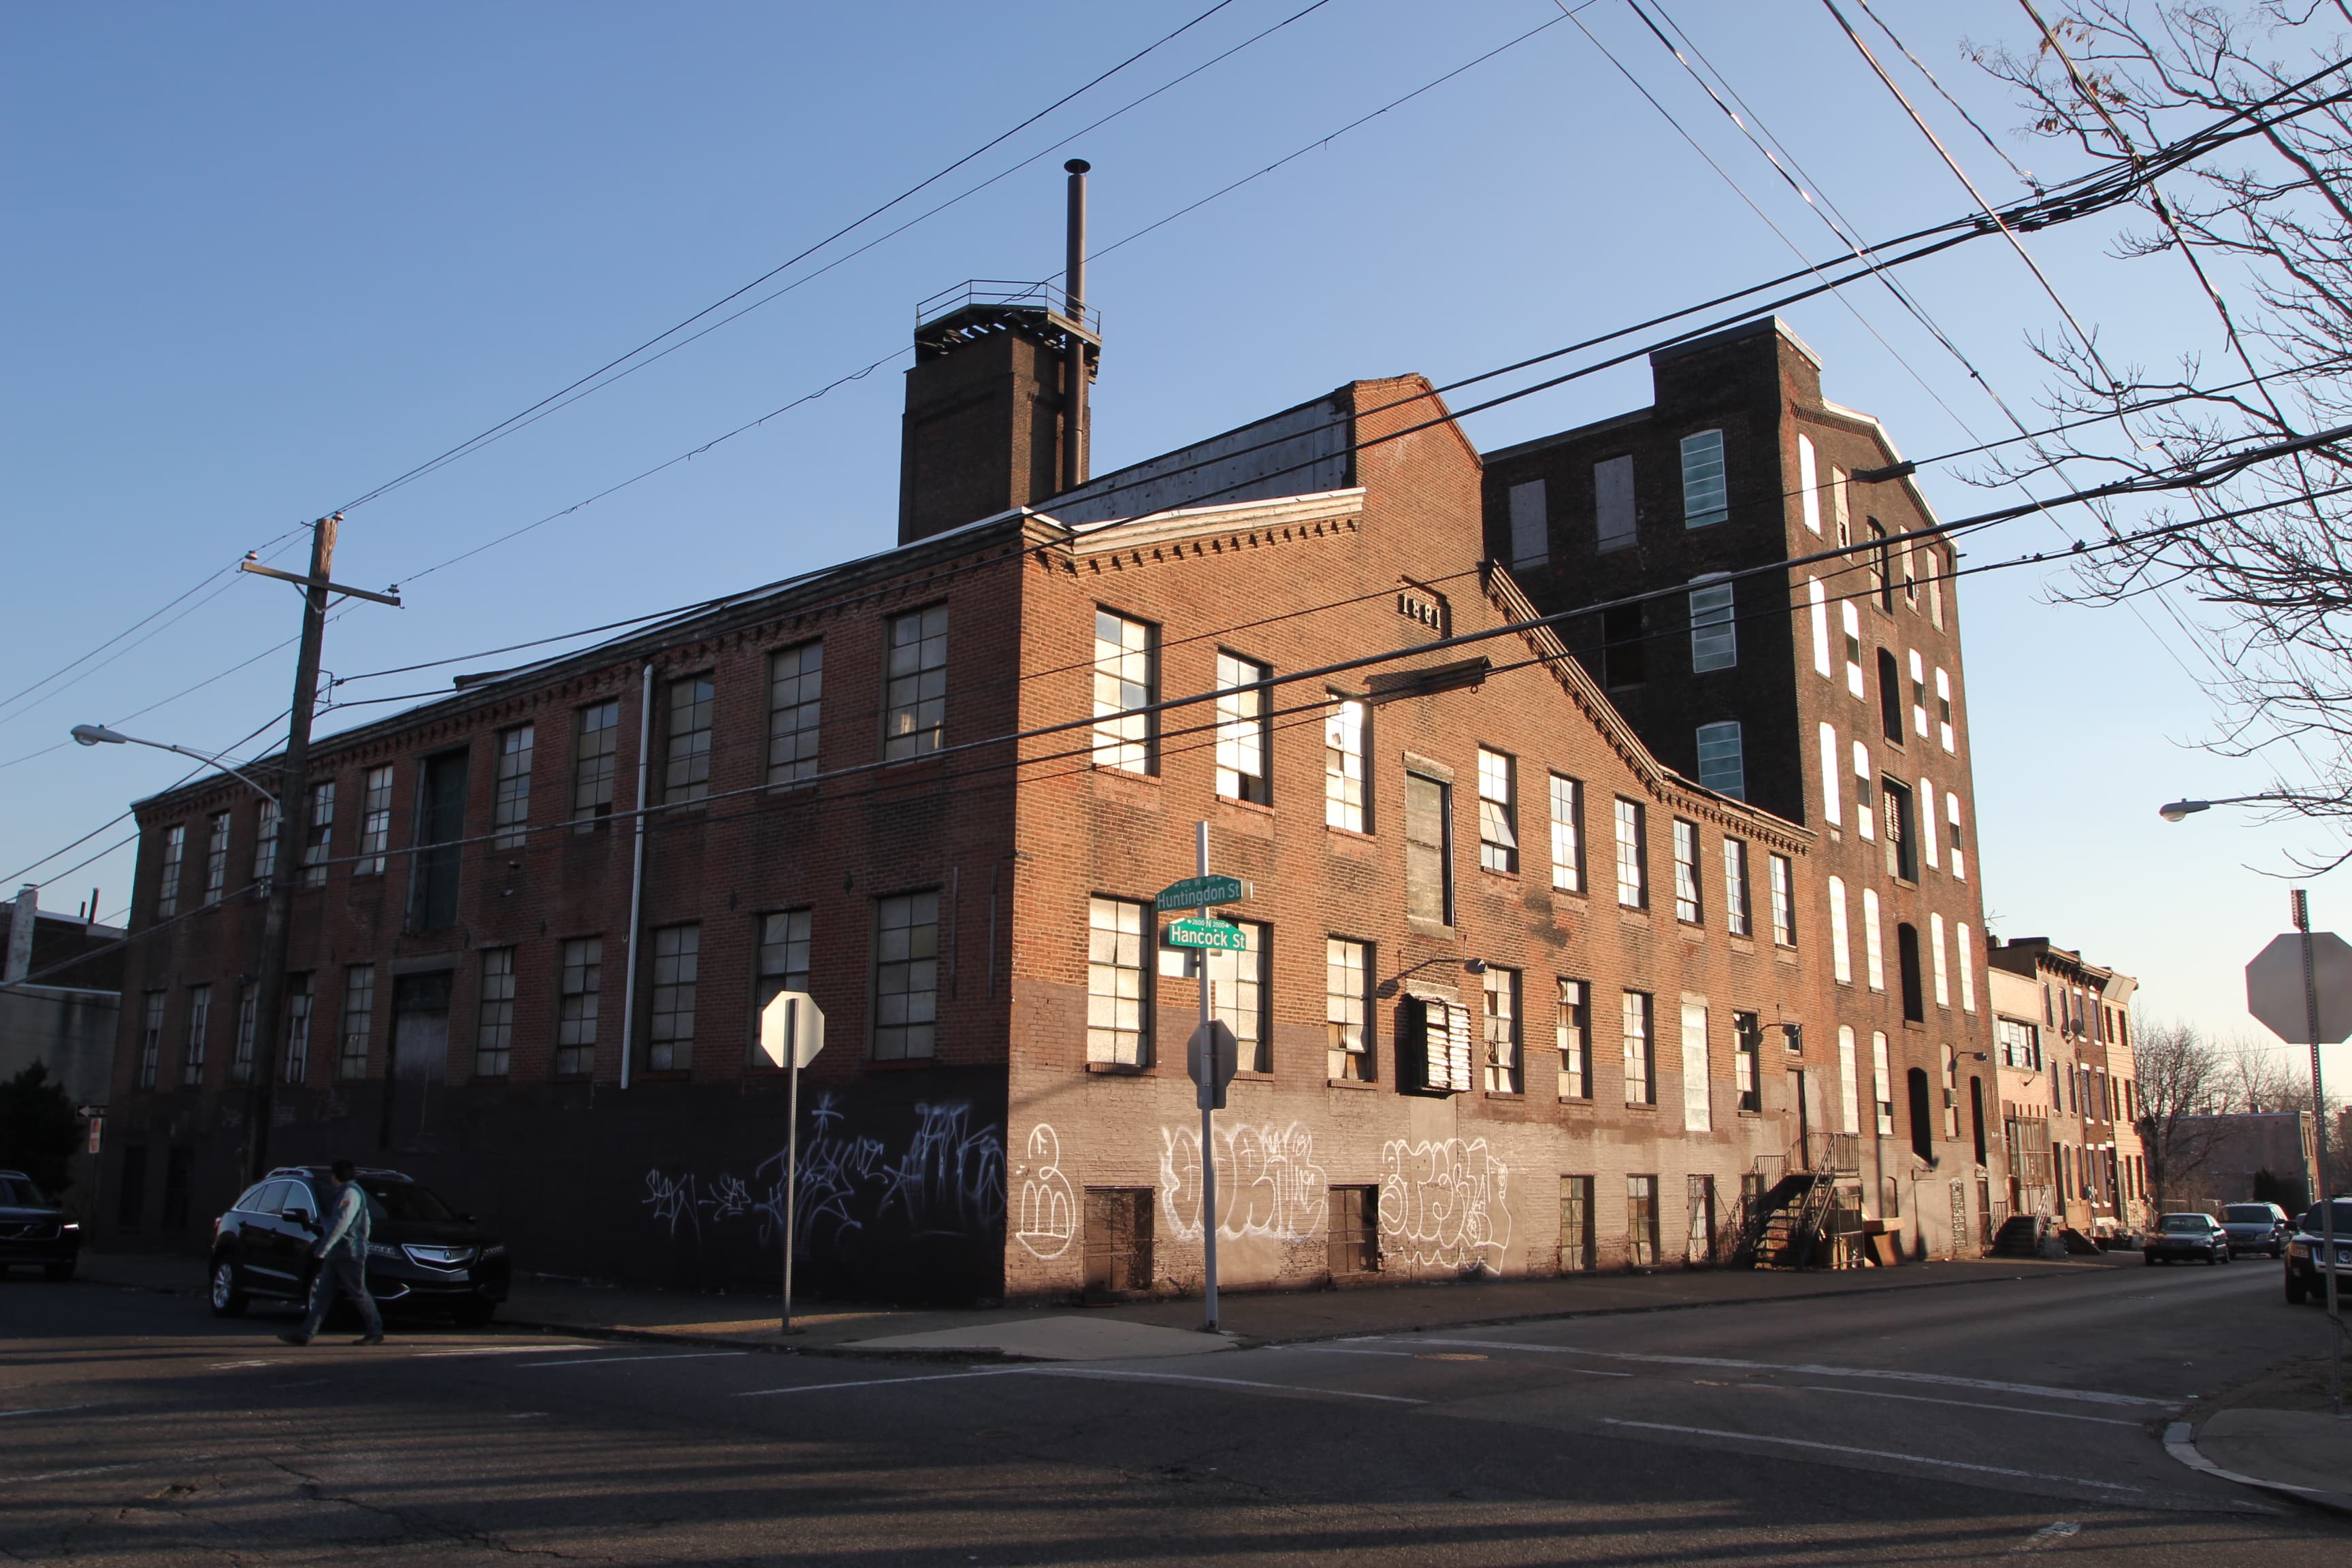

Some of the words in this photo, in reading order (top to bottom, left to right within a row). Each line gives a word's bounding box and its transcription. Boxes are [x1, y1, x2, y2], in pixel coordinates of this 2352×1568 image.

[1194, 878, 1201, 887] W
[1157, 885, 1225, 909] Huntingdon
[1228, 883, 1240, 898] St
[1206, 919, 1211, 928] N
[1171, 925, 1228, 947] Hancock
[1232, 934, 1245, 949] St
